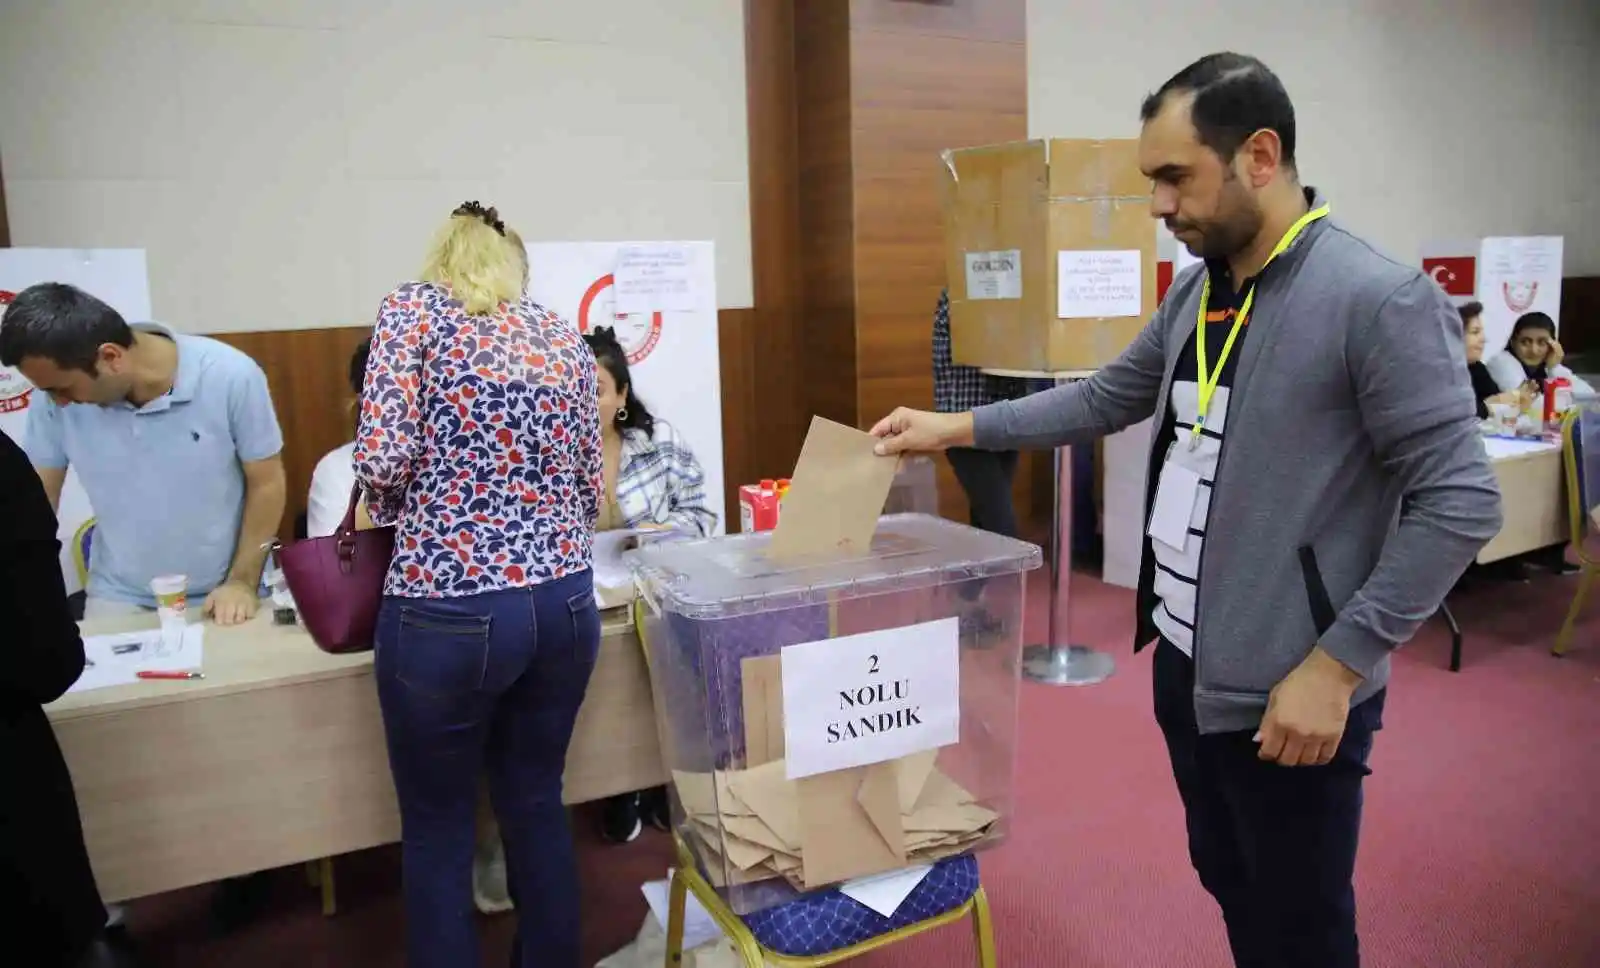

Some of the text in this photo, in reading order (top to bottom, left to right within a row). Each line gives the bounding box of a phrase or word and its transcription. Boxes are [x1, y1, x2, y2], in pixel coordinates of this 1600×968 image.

[867, 654, 880, 674] 2
[839, 680, 910, 710] NOLU
[827, 705, 922, 744] SANDIK
